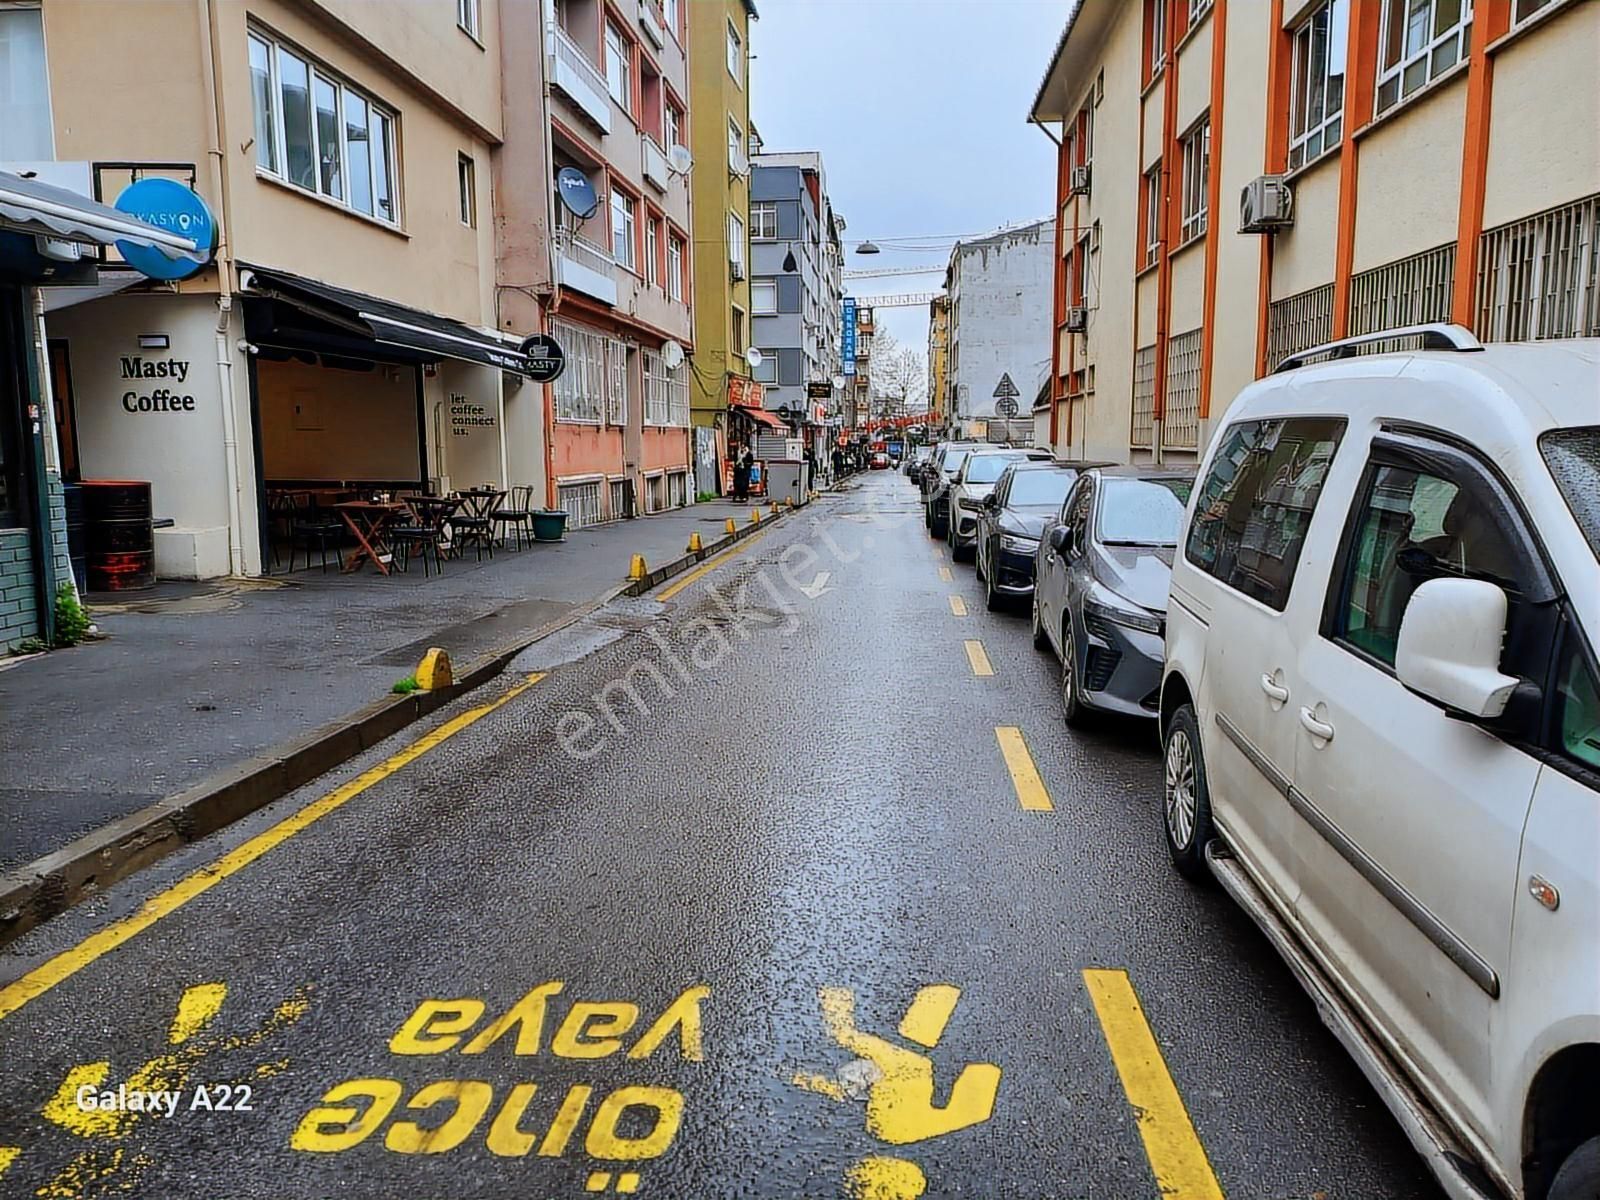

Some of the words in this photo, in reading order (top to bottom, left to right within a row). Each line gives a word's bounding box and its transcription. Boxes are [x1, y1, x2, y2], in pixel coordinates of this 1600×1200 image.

[120, 357, 189, 383] Masty
[122, 389, 195, 412] Coffee
[451, 393, 465, 404] let
[451, 404, 484, 415] coffee
[452, 416, 495, 426] connect
[387, 979, 712, 1062] yaya
[288, 1078, 684, 1194] önce
